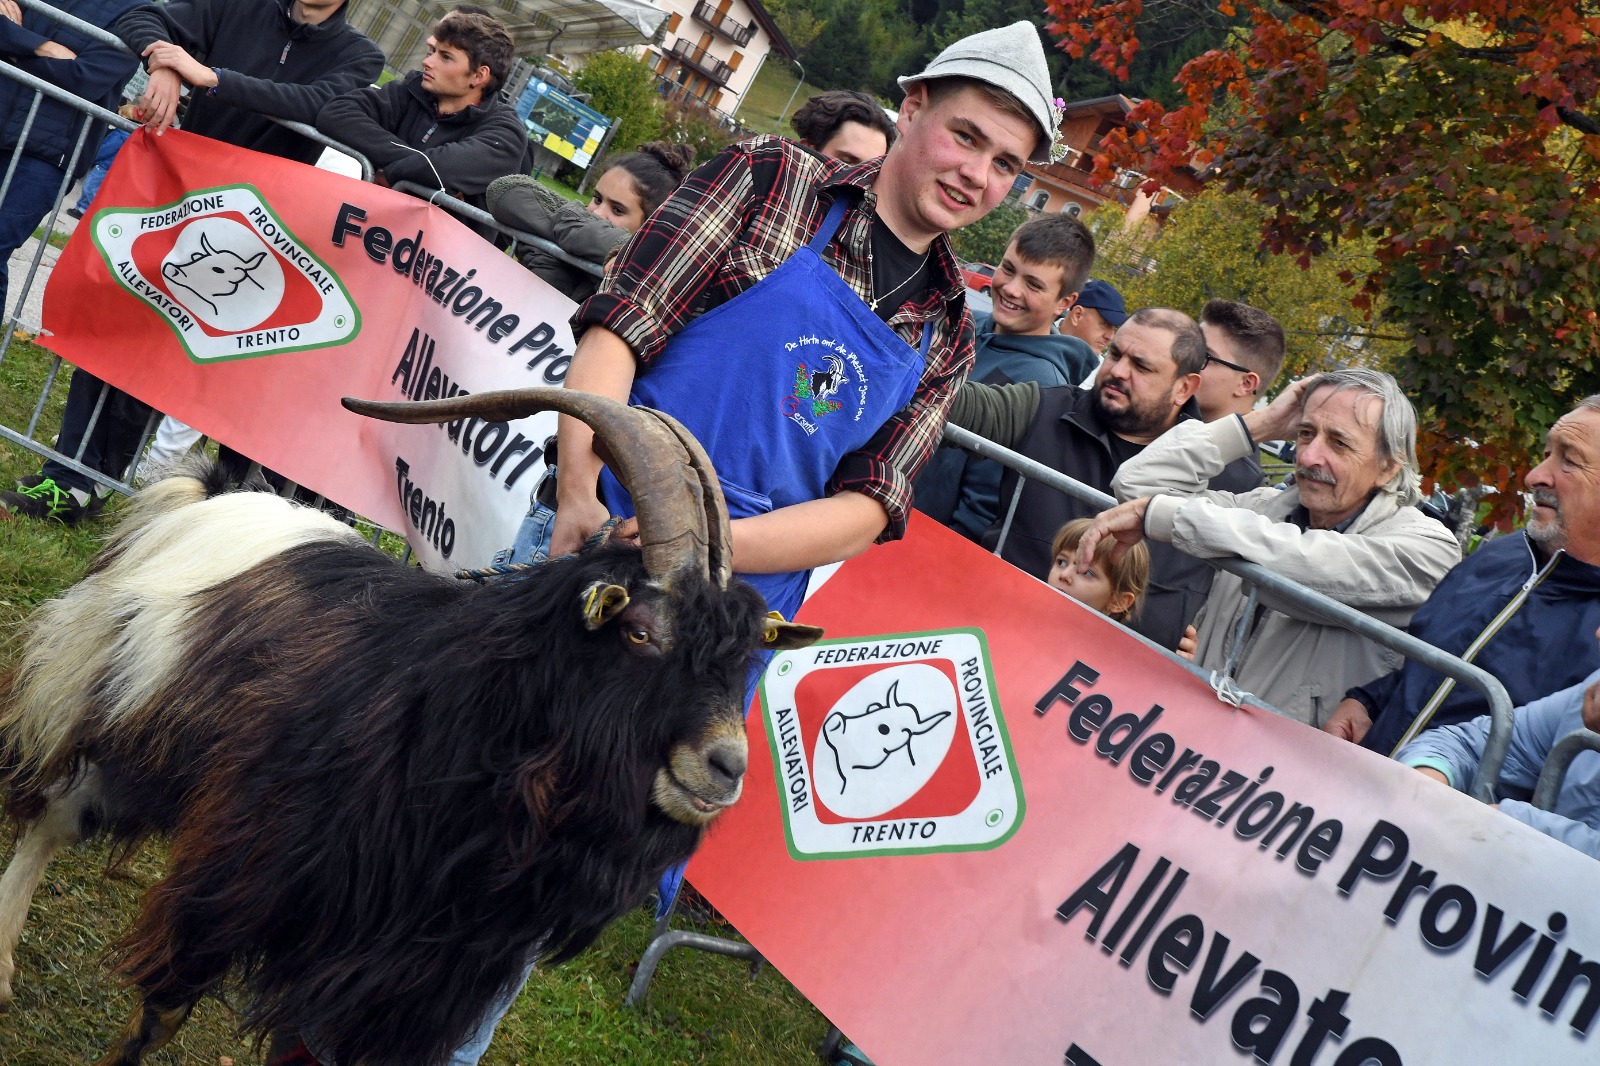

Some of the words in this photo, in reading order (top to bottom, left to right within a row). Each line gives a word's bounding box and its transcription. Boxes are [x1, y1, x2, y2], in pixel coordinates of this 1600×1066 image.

[117, 260, 194, 332] ALLEVATORI
[248, 206, 335, 296] PROVINCIALE
[331, 202, 521, 342] Federazione
[236, 327, 300, 349] TRENTO
[395, 456, 455, 557] Trento
[814, 639, 943, 664] FEDERAZIONE
[775, 707, 809, 813] ALLEVATORI
[961, 656, 1003, 780] PROVINCIALE
[1034, 660, 1344, 873] Federazione
[852, 820, 937, 843] TRENTO
